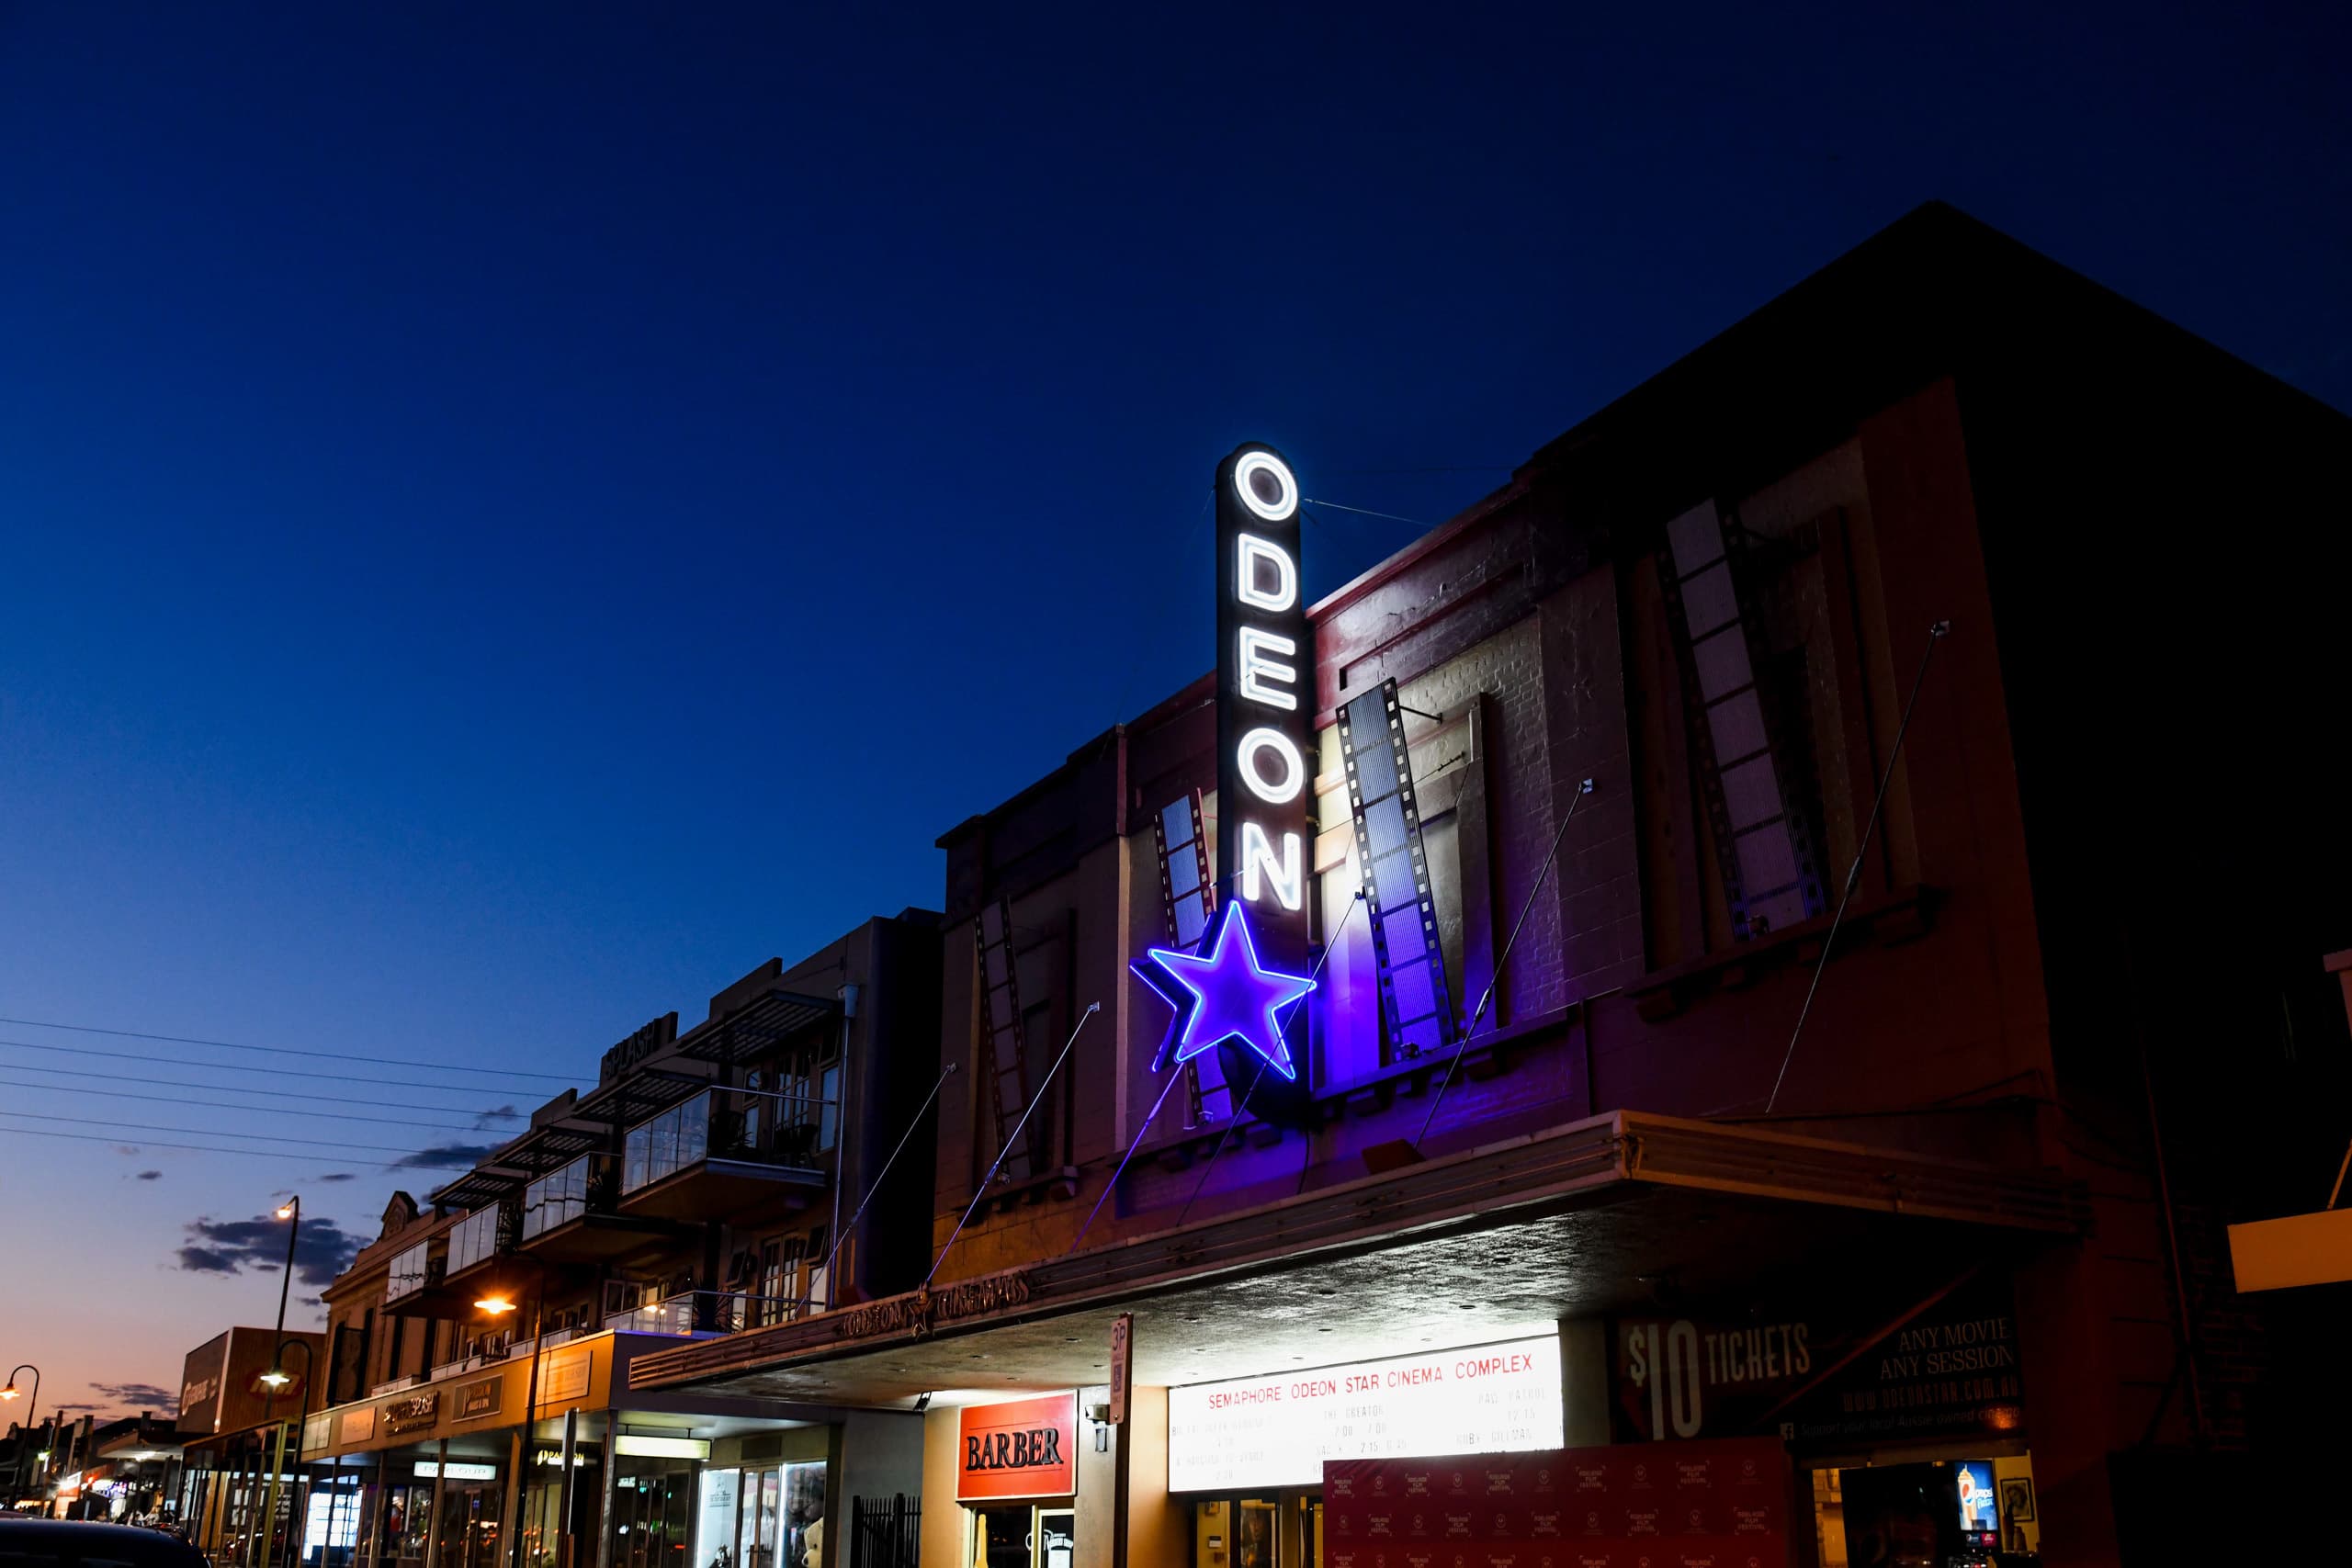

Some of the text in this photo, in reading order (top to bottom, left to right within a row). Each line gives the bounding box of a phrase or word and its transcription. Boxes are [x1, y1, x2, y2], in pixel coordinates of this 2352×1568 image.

[1235, 450, 1304, 910] ODEON
[937, 1272, 1028, 1318] CINEMAS
[1113, 1325, 1125, 1351] 3P
[1898, 1317, 2010, 1352] ANY MOVIE
[1208, 1353, 1533, 1410] SEMAPHORE ODEON STAR CINEMA COMPLEX
[1628, 1320, 1811, 1441] $10 TICKETS
[1880, 1345, 2015, 1380] ANY SESSION
[966, 1428, 1064, 1472] BARBER
